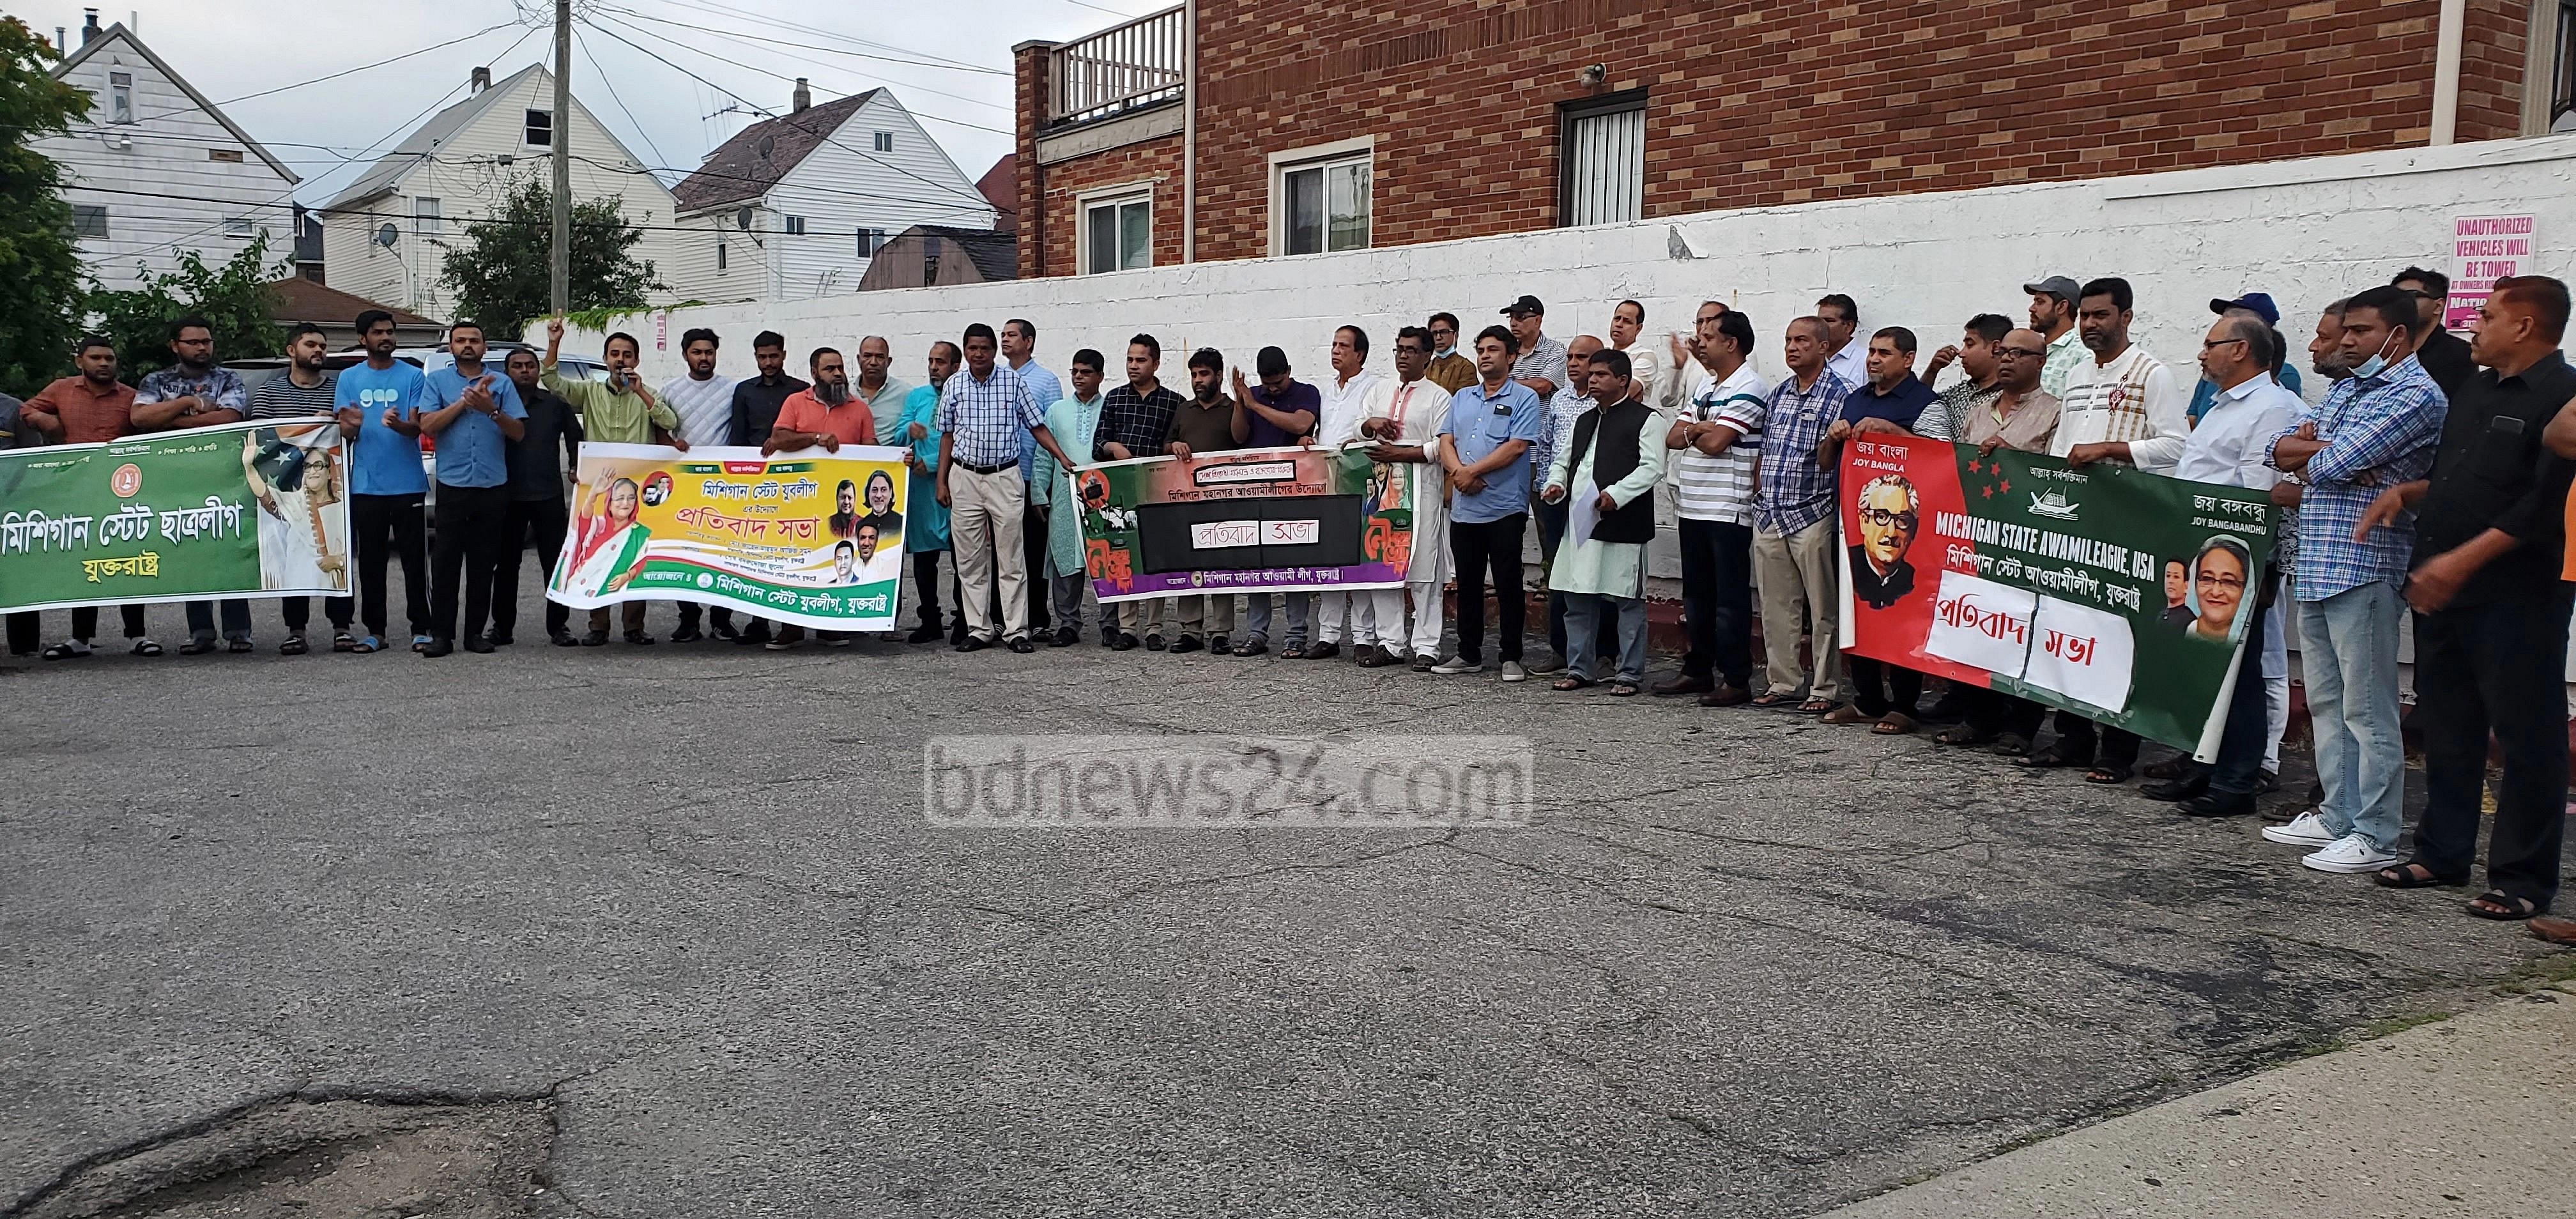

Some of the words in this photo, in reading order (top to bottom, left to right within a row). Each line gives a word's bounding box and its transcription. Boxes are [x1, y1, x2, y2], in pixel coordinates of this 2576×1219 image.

[2457, 217, 2533, 236] UNAUTHORIZED
[2457, 239, 2504, 257] VEHICLES
[2506, 238, 2529, 256] WILL
[2465, 261, 2479, 277] BE
[2481, 261, 2517, 277] TOWED
[2451, 281, 2458, 289] AT
[2459, 280, 2483, 289] OWNERS
[2485, 280, 2495, 289] RIS
[360, 388, 399, 408] gap
[1856, 441, 1876, 456] জয়
[1878, 444, 1910, 460] বাংলা
[1852, 458, 1869, 467] JOY
[1871, 460, 1905, 473] BANGLA
[703, 480, 749, 498] মিশিগান
[753, 482, 778, 498] স্টেট
[782, 479, 818, 501] যুবলীগ
[2193, 494, 2218, 512] জয়
[2220, 499, 2268, 524] বঙ্গবন্ধু
[1, 510, 93, 556] মিশিগান
[99, 502, 155, 546] স্টেট
[159, 496, 243, 545] ছাত্রলীগ
[677, 507, 770, 540] প্রতিবাদ
[776, 516, 821, 542] সভা
[2191, 516, 2207, 526] JOY
[2208, 518, 2267, 535] BANGABANDHU
[1935, 511, 2001, 547] MICHIGAN
[2001, 523, 2038, 553] STATE
[2038, 531, 2130, 578] AWAMILEAGUE,
[2132, 550, 2155, 582] USA
[82, 549, 160, 583] যুক্তরাষ্ট্র
[1946, 544, 1995, 574] মিশিগান
[1996, 555, 2023, 578] স্টেট
[716, 574, 766, 601] মিশিগান
[767, 589, 798, 606] স্টেট
[1938, 593, 2028, 645] প্রতিবাদ
[2044, 628, 2099, 666] সভা
